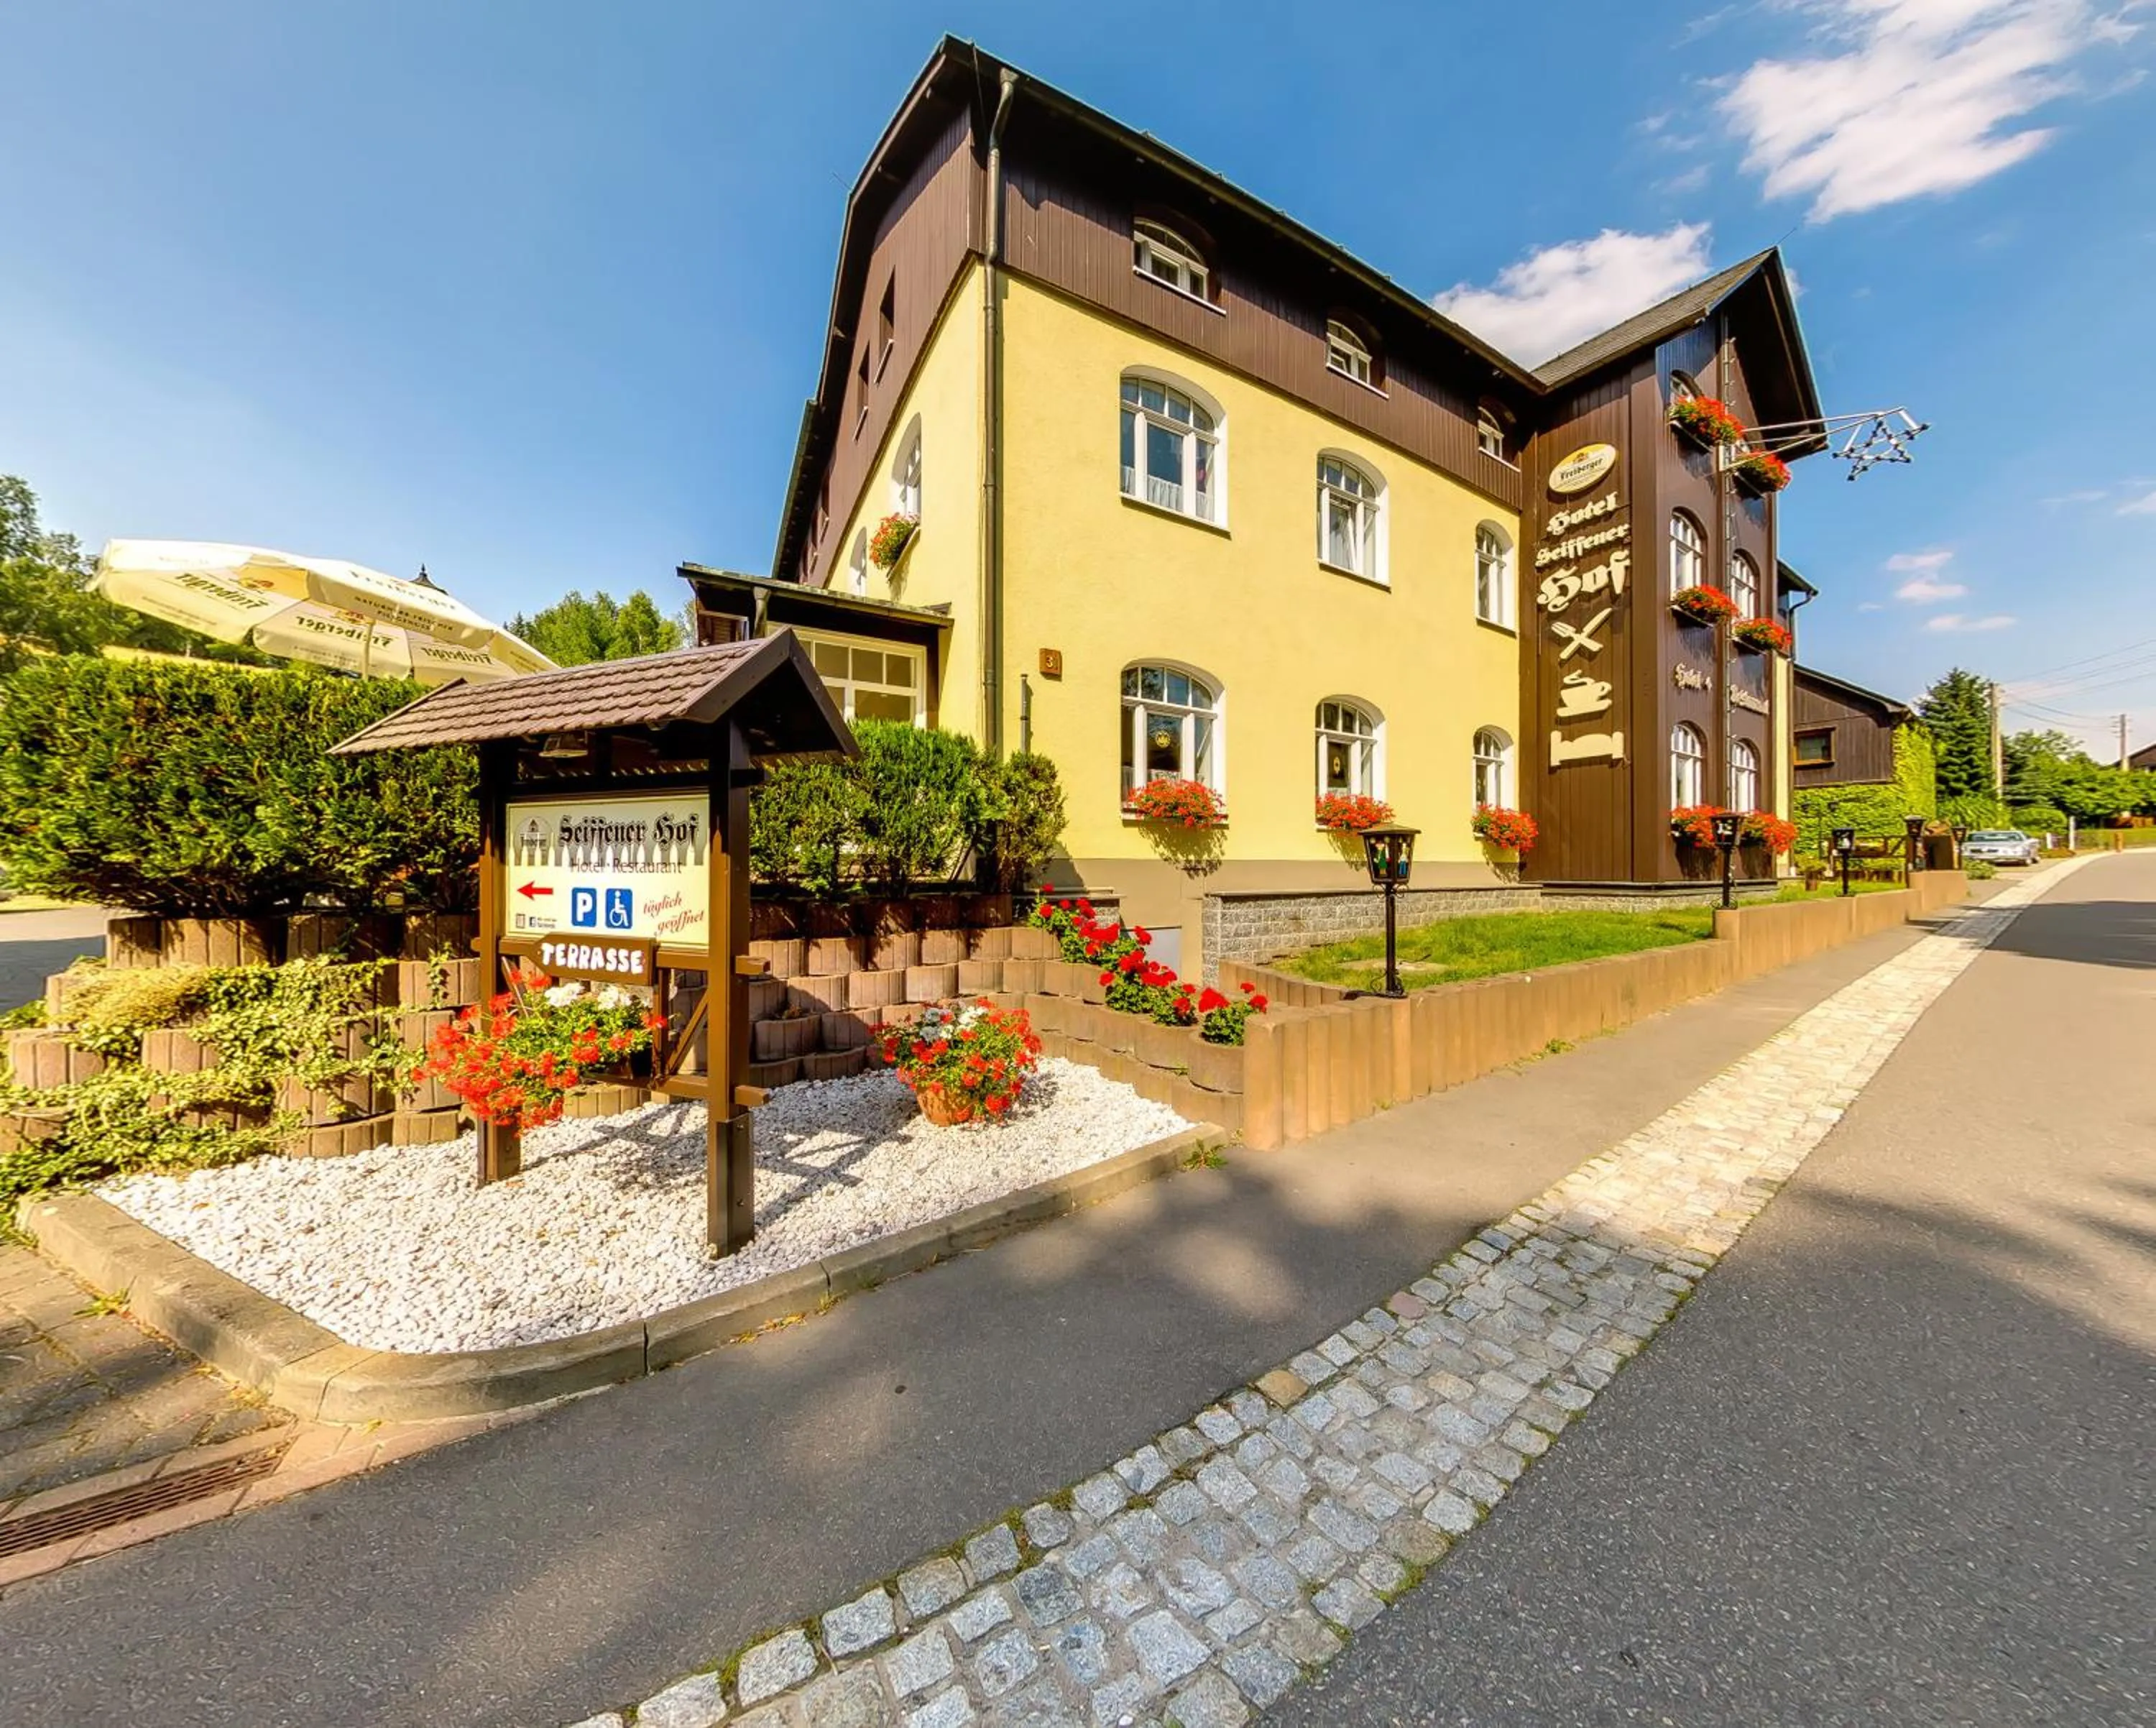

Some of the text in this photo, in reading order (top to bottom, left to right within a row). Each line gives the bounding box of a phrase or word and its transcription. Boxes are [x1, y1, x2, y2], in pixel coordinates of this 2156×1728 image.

[1547, 491, 1618, 536] Hotel
[1535, 523, 1630, 566] Seiffener
[1537, 549, 1631, 612] Hof
[1046, 655, 1054, 668] 3
[558, 812, 699, 852] Seiffener Hof
[571, 857, 683, 873] Hotel Restaurant
[576, 892, 593, 922] P
[642, 891, 683, 918] täglich
[654, 909, 705, 937] geöffnet
[540, 943, 644, 975] TERRASSE
